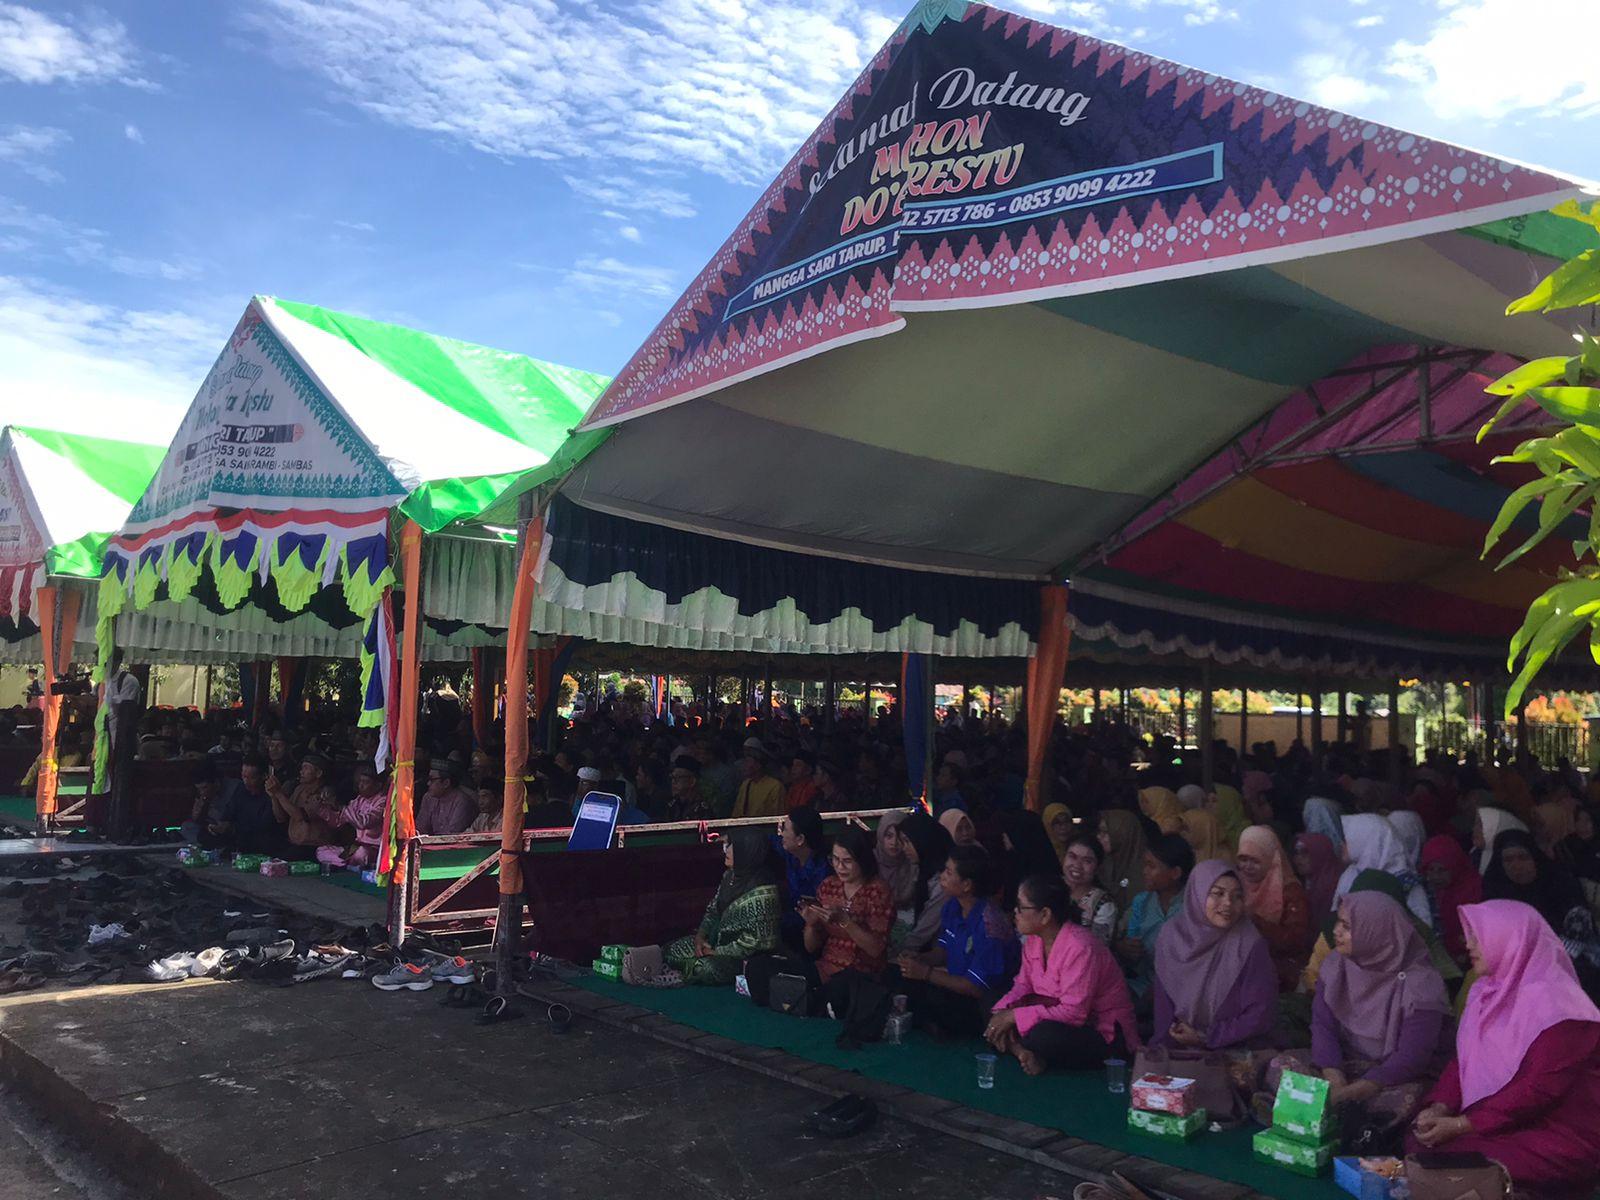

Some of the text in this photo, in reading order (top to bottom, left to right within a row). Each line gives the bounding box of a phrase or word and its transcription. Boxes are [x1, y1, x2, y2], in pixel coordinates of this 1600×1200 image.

[800, 67, 1091, 214] elama Datang
[905, 143, 1025, 197] RESTU
[752, 269, 805, 300] MANGGA
[807, 254, 836, 279] SARI
[838, 235, 886, 264] TARUP,
[921, 206, 959, 225] 5713
[962, 203, 996, 221] 786
[1009, 189, 1052, 214] 0853
[1053, 177, 1103, 204] 9099
[1104, 168, 1157, 193] 4222
[235, 427, 266, 443] TAUP
